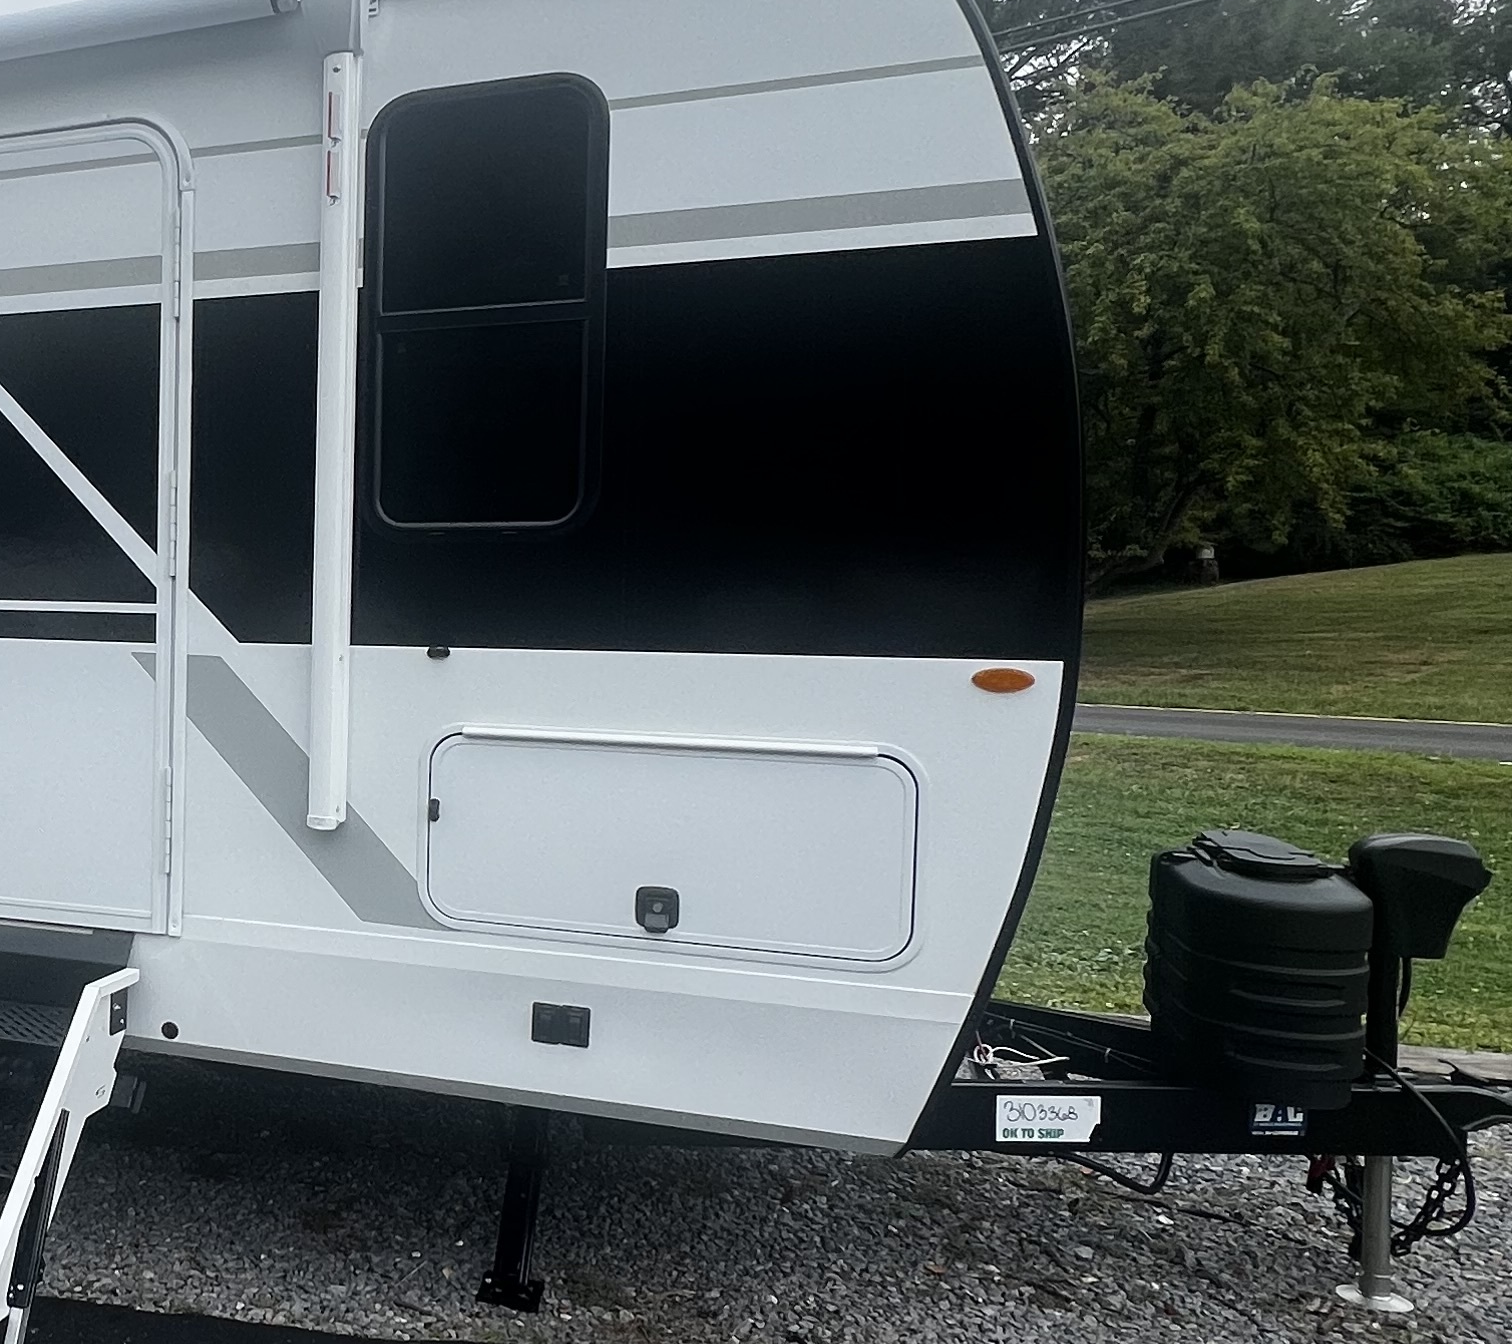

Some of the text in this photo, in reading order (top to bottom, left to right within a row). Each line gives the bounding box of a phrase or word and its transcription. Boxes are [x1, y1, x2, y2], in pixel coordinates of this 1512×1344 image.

[1002, 1128, 1065, 1139] OK TO SHIP
